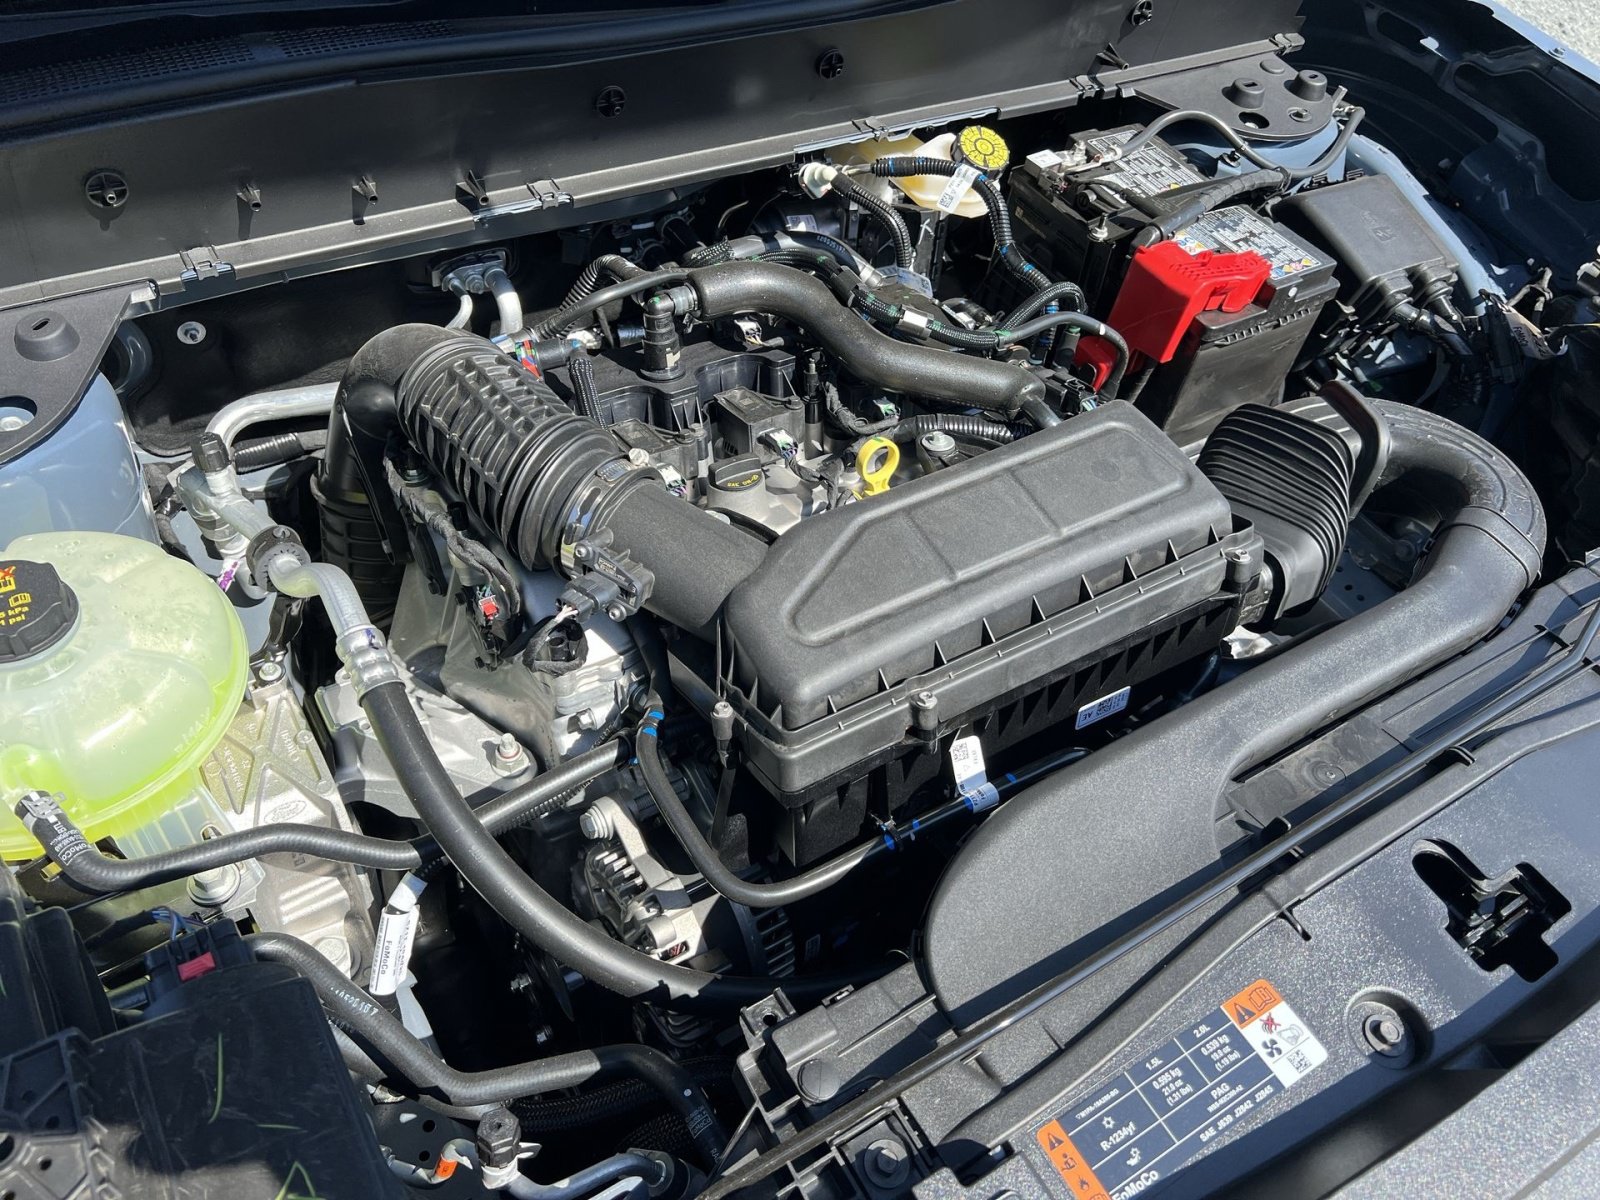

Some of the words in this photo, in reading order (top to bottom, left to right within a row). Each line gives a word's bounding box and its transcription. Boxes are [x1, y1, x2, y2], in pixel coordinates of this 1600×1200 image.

[7, 606, 29, 616] kPa
[8, 614, 26, 625] psi
[380, 940, 393, 975] FoMoCo
[1193, 1024, 1210, 1038] 2.0L
[1215, 1033, 1230, 1048] kg
[1145, 1057, 1163, 1071] 1.5L
[1168, 1067, 1182, 1081] kg
[1210, 1083, 1230, 1100] PAG
[1100, 1121, 1136, 1151] R-1234yf
[1200, 1127, 1217, 1142] SAE
[1111, 1170, 1159, 1200] FoMoCo
